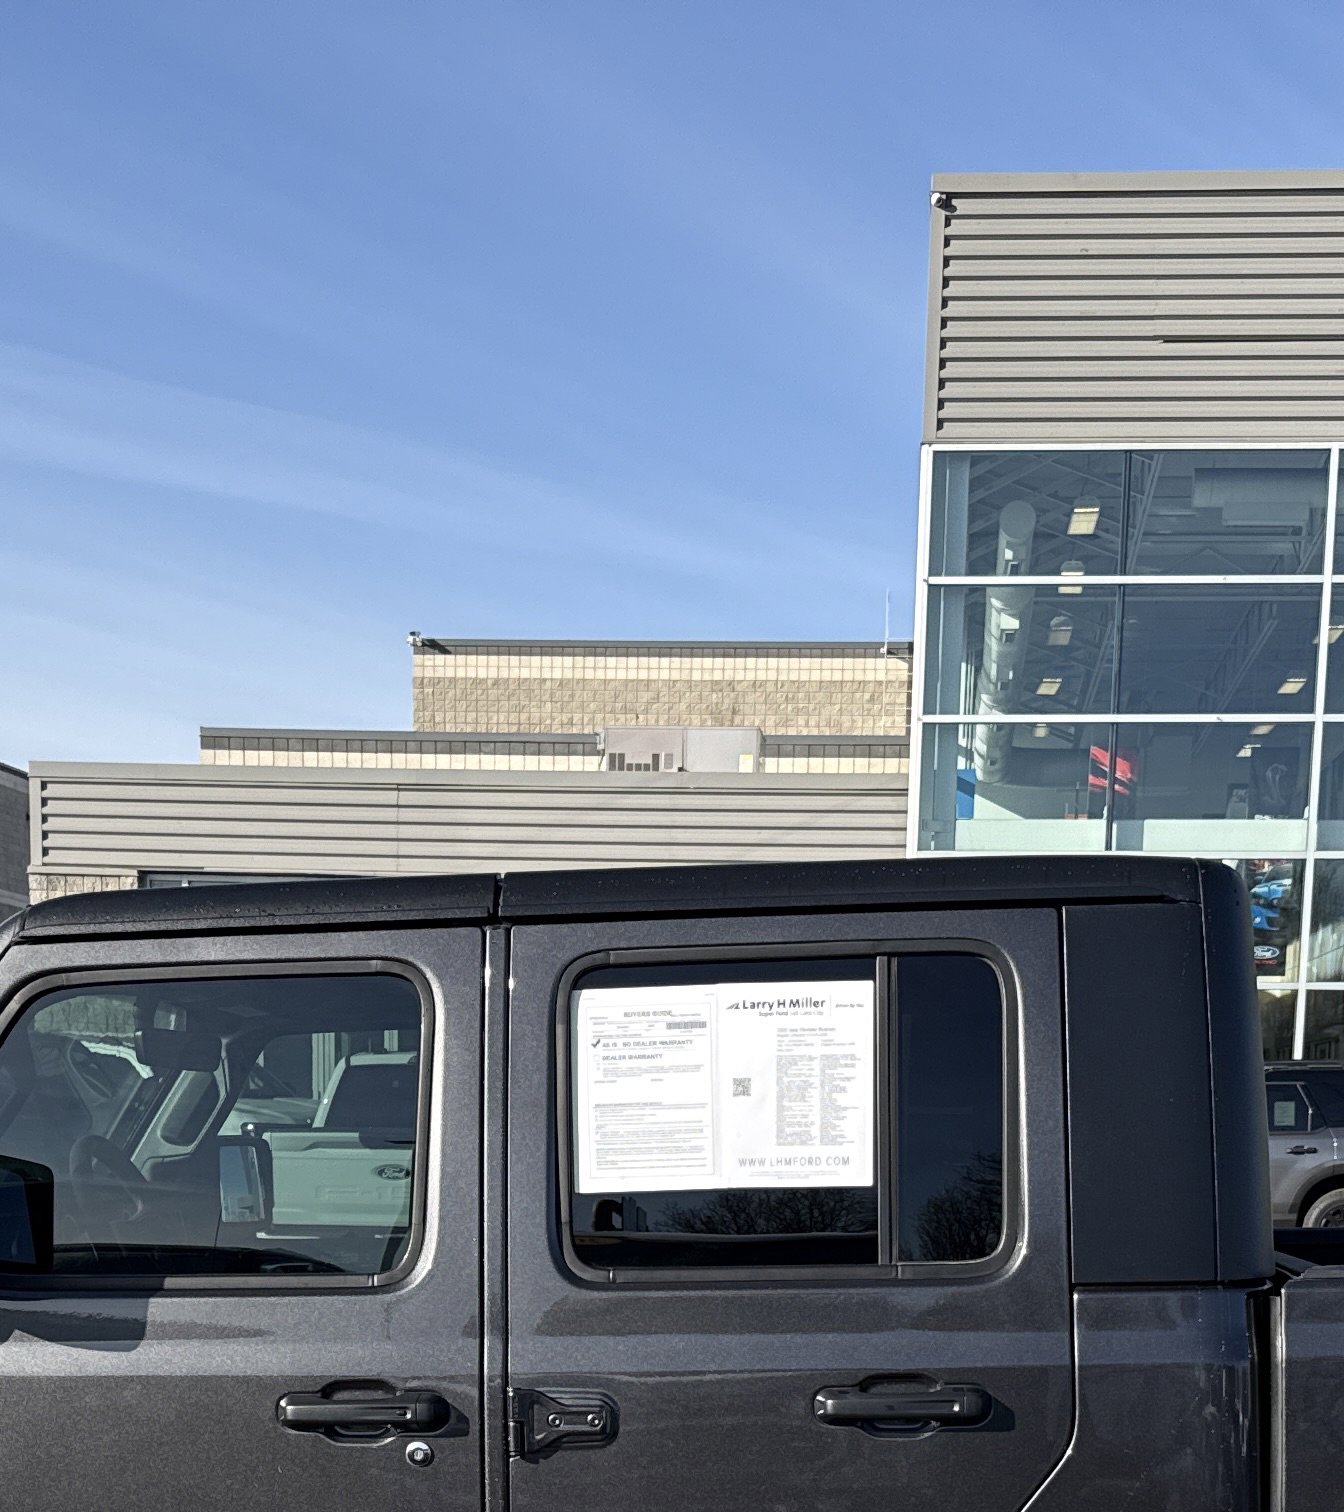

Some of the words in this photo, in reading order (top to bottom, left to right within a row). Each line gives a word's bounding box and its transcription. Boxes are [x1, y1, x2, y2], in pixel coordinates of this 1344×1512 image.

[742, 1000, 774, 1011] Larry
[777, 999, 786, 1008] H
[789, 997, 826, 1008] Miller
